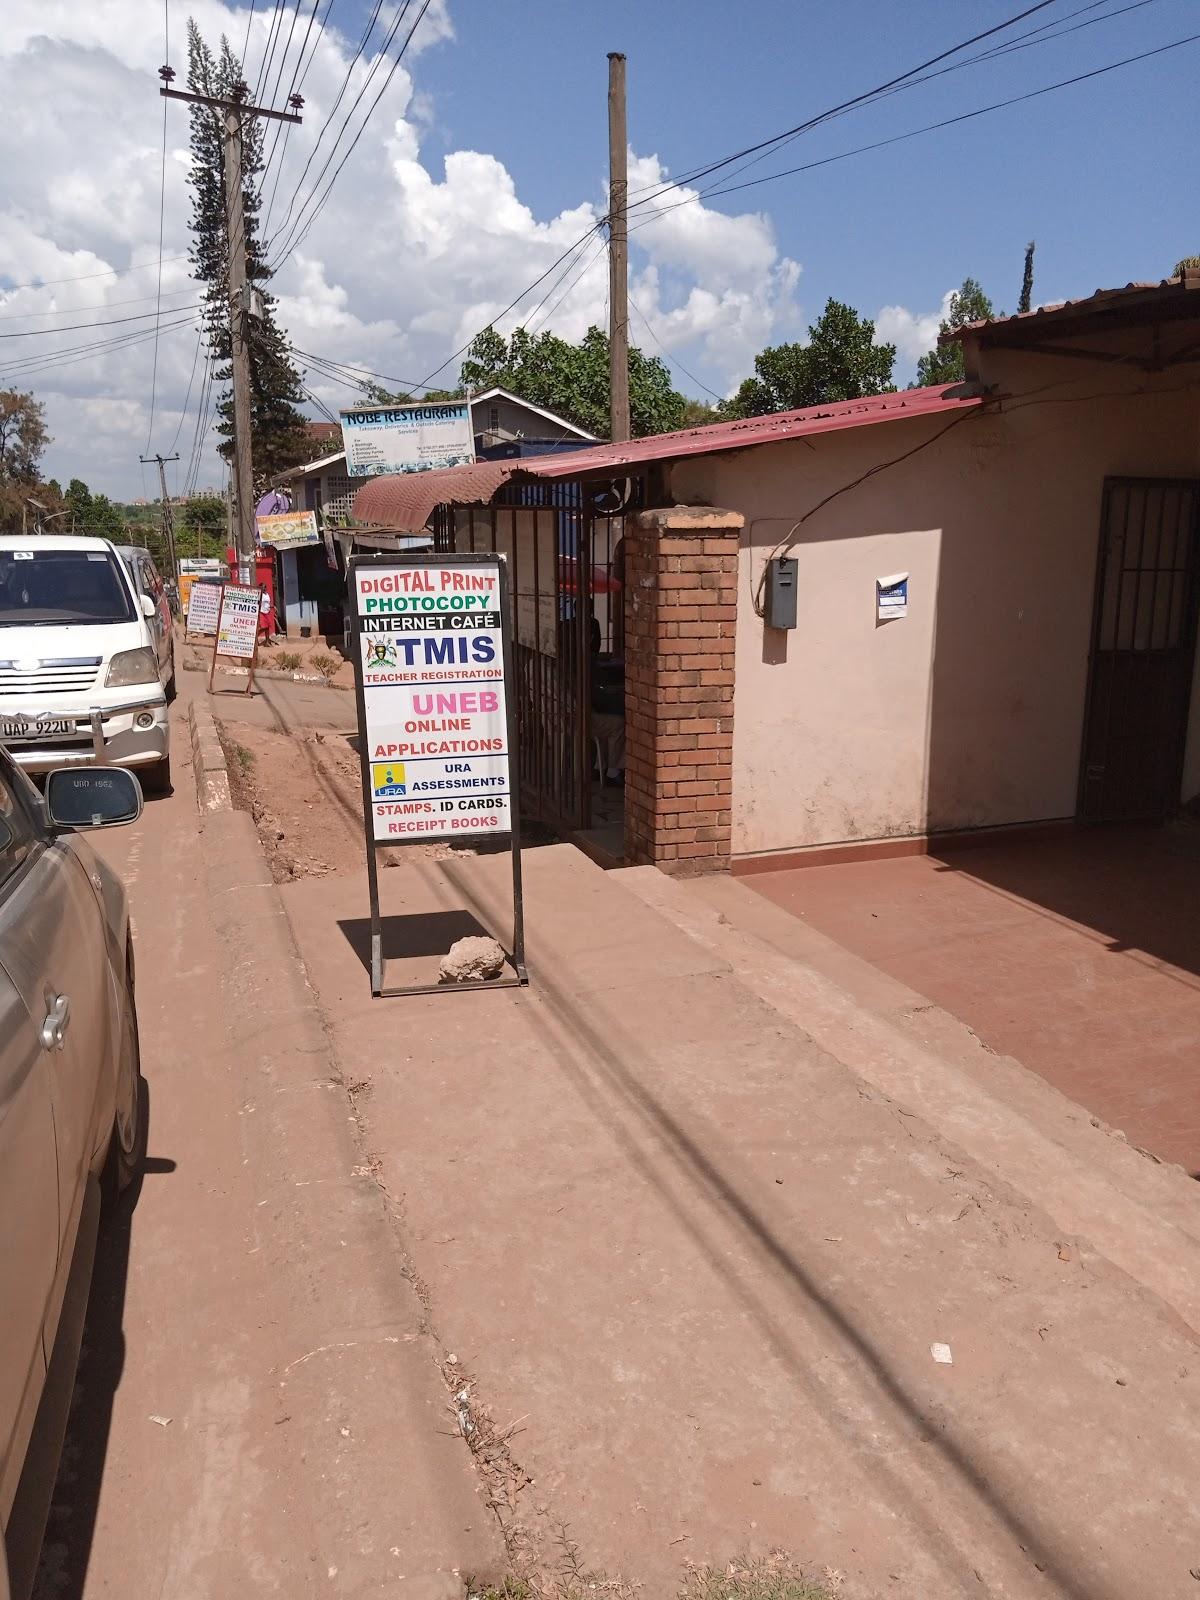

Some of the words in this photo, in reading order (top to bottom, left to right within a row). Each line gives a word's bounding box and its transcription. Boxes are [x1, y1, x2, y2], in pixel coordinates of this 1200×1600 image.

[347, 413, 381, 425] NOBE
[384, 406, 464, 423] RESTAURANT
[360, 570, 435, 594] DIGITAL
[440, 571, 496, 591] PRINT
[232, 602, 257, 614] TMIS
[365, 595, 490, 613] PHOTOCOPY
[233, 617, 256, 626] UNEB
[363, 616, 446, 632] INTERNET
[451, 612, 495, 629] CAFÉ
[396, 635, 495, 666] TMIS
[365, 672, 418, 683] TEACHER
[421, 669, 502, 681] REGISTRATION
[412, 691, 499, 716] UNEB
[3, 722, 29, 736] UAP
[36, 720, 69, 735] 922U
[404, 718, 472, 733] ONLINE
[374, 738, 503, 758] APPLICATIONS
[444, 763, 472, 774] URA
[378, 787, 405, 796] URA
[412, 776, 505, 791] ASSESSMENTS
[376, 802, 436, 816] STAMPS.
[440, 801, 454, 812] ID
[457, 797, 507, 811] CARDS.
[388, 819, 447, 834] RECEIPT
[451, 816, 499, 829] BOOKS
